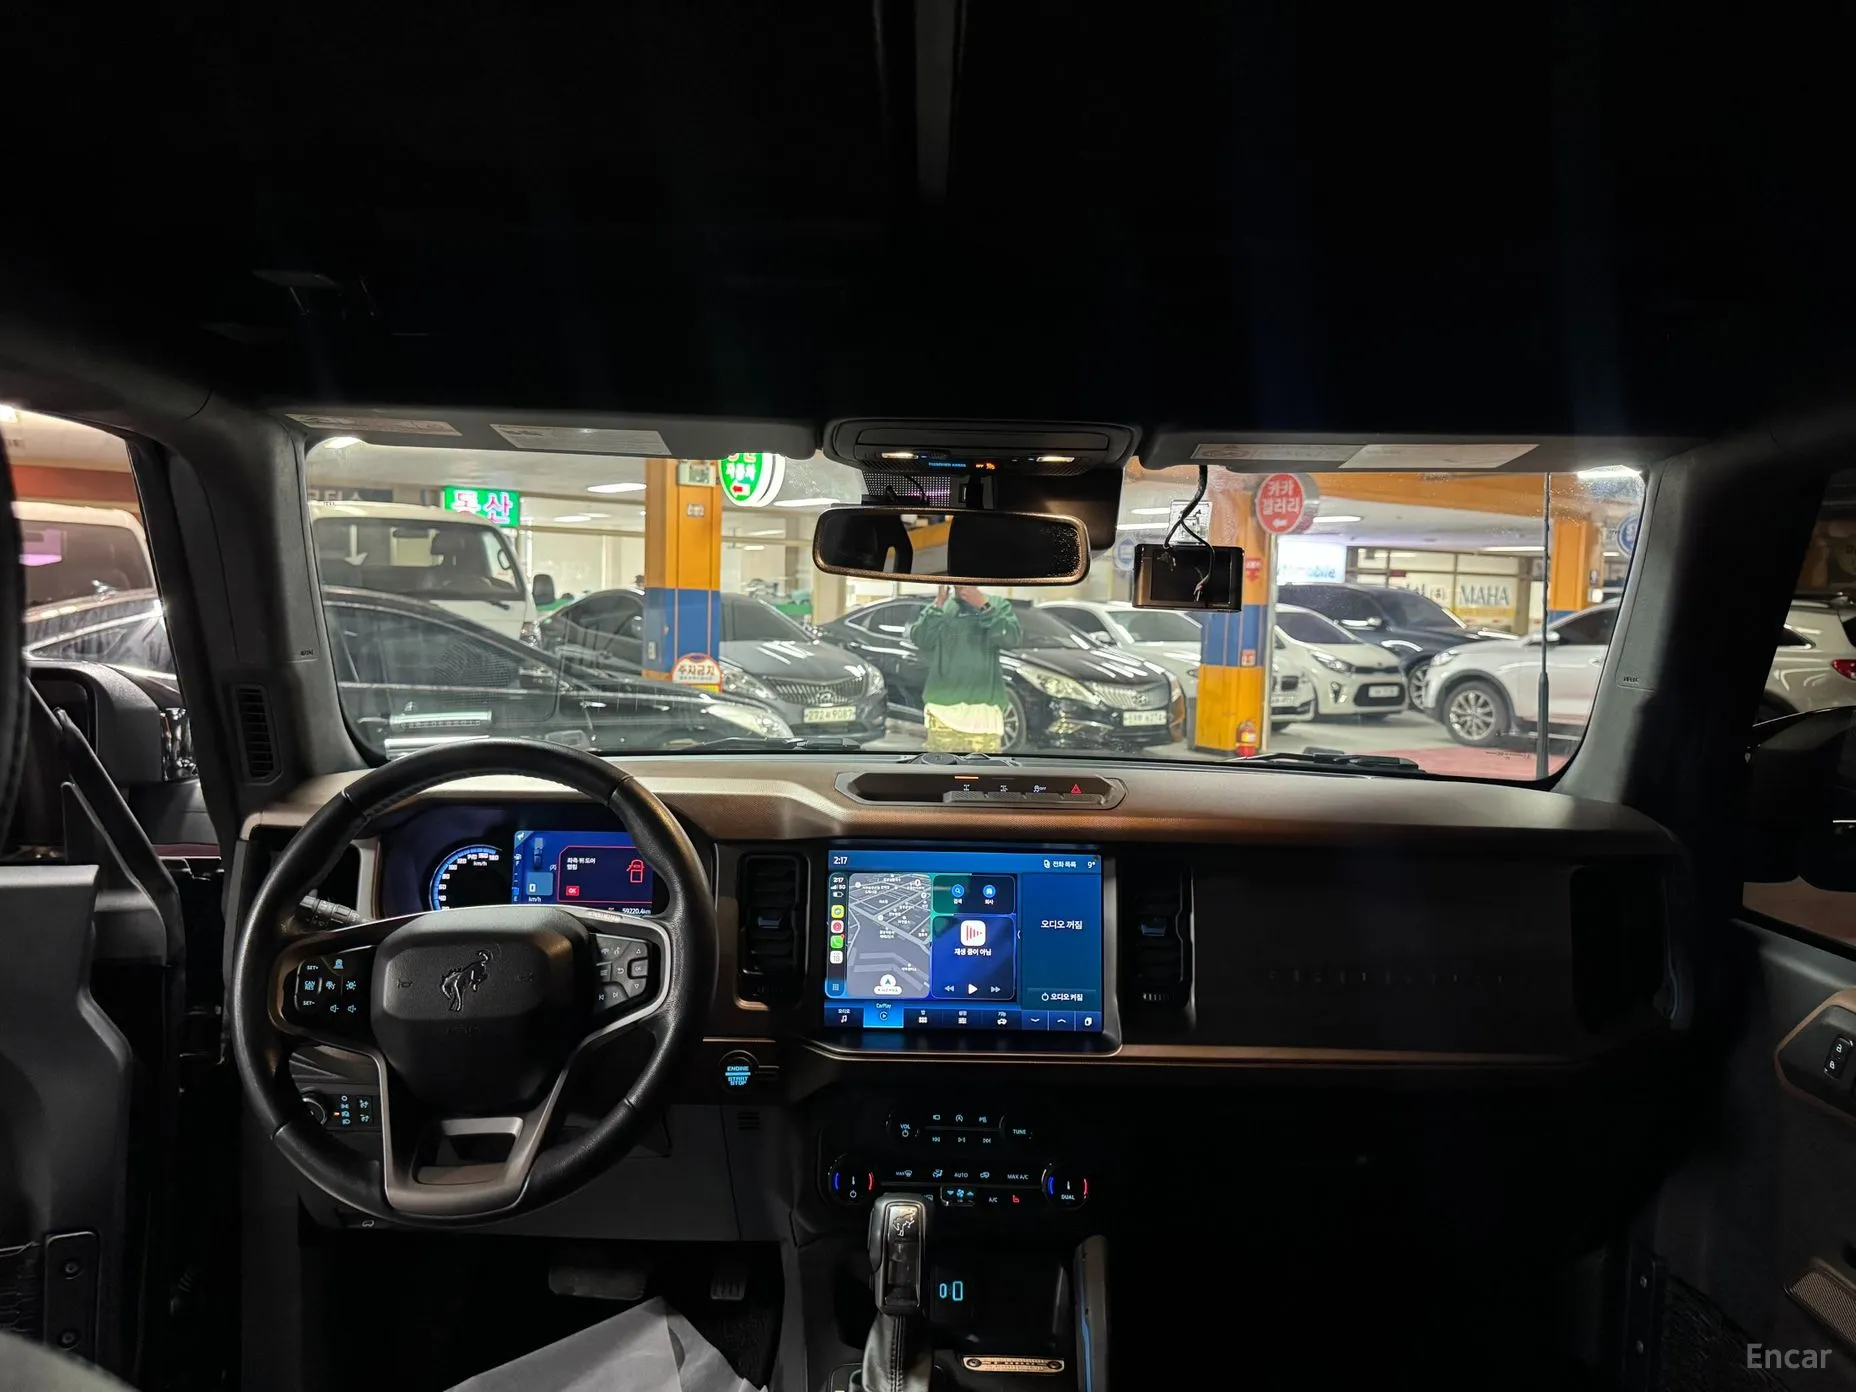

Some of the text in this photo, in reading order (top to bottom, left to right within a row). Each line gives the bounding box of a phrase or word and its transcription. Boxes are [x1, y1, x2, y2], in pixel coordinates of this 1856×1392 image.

[1459, 584, 1510, 606] MAHA
[678, 663, 715, 676] 주차금지
[833, 856, 848, 865] 2:17
[1052, 860, 1064, 868] 전화
[1041, 920, 1083, 930] 오디오 꺼짐
[1050, 993, 1070, 1001] 오디오
